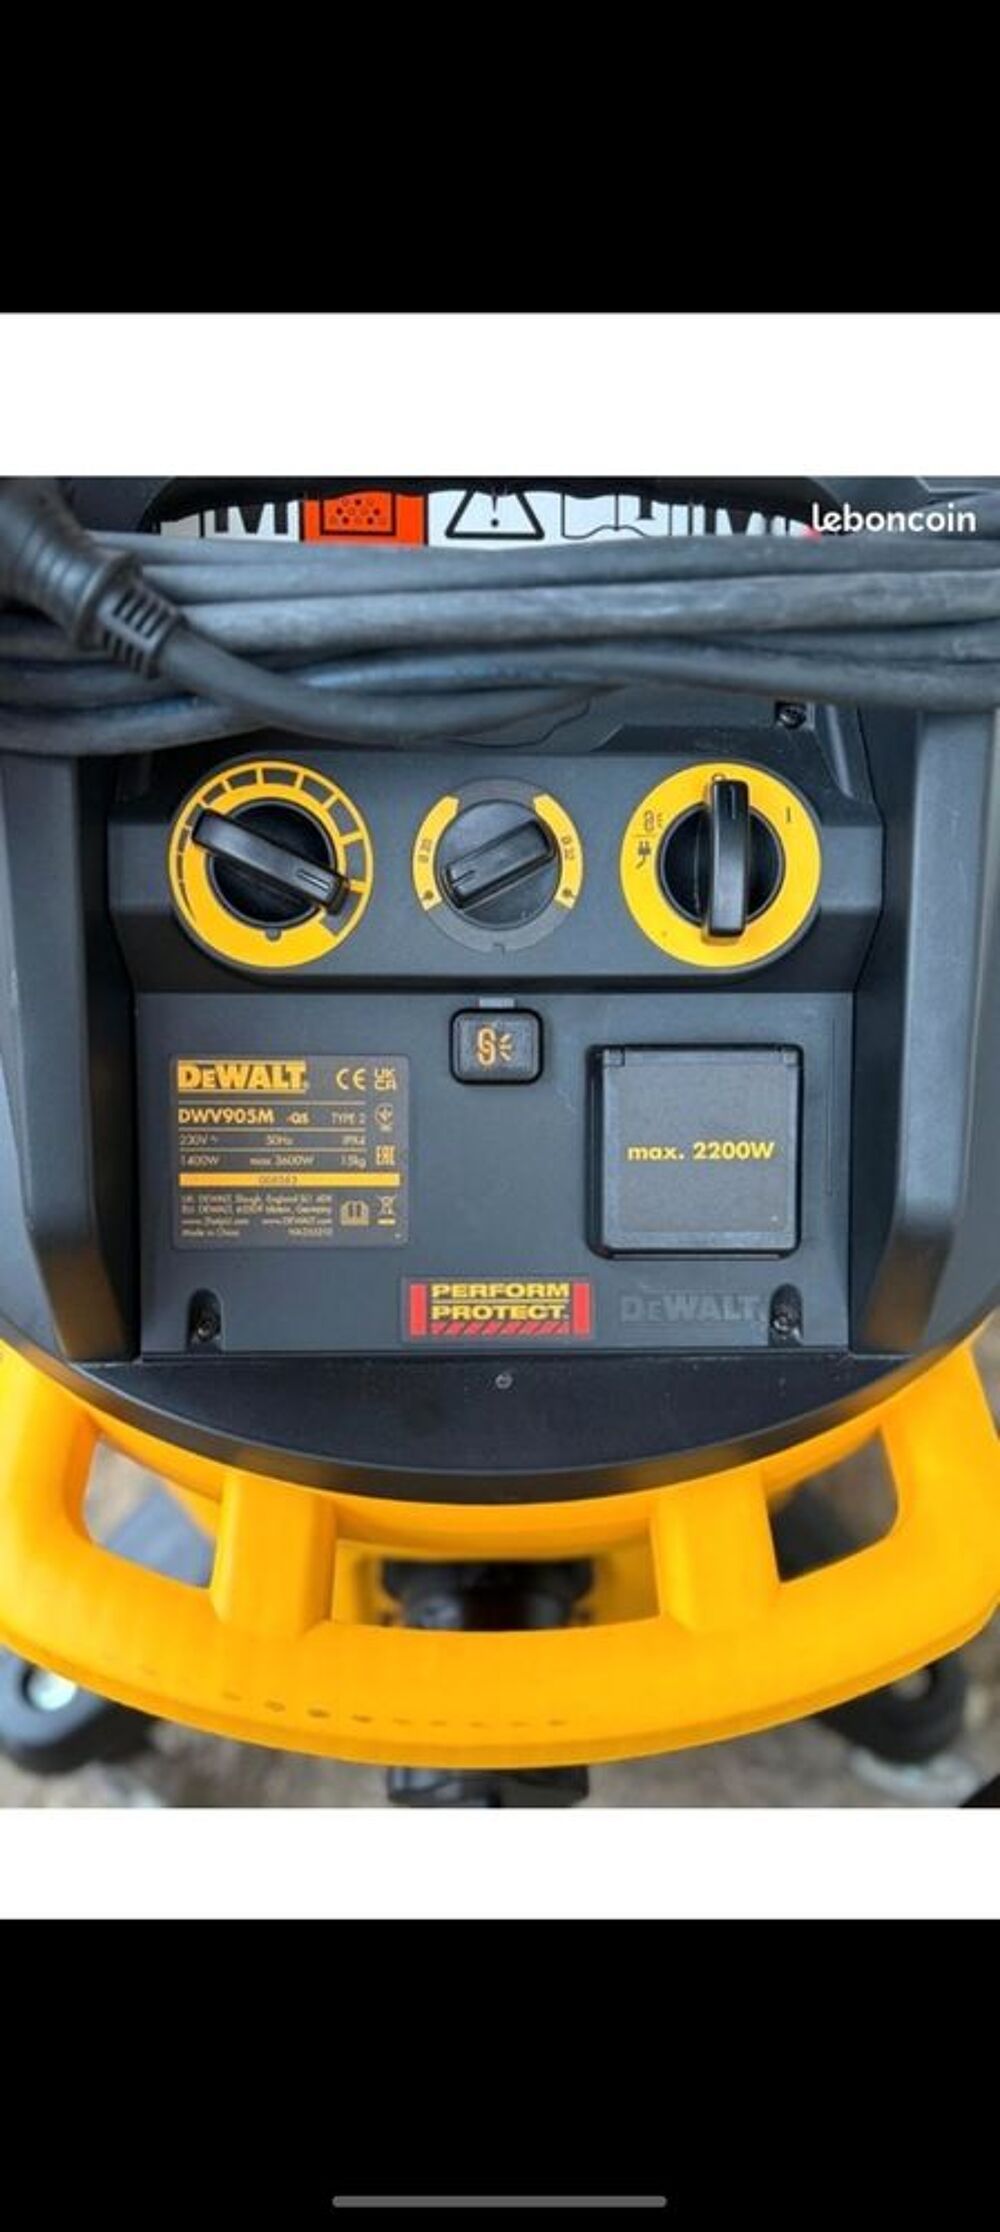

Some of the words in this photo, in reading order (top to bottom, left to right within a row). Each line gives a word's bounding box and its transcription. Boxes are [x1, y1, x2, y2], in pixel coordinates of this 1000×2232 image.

[178, 1108, 274, 1125] DWV905M
[331, 1112, 357, 1125] TYPE
[628, 1146, 684, 1160] max.
[693, 1141, 774, 1160] 2200W
[431, 1283, 570, 1298] PERFORM
